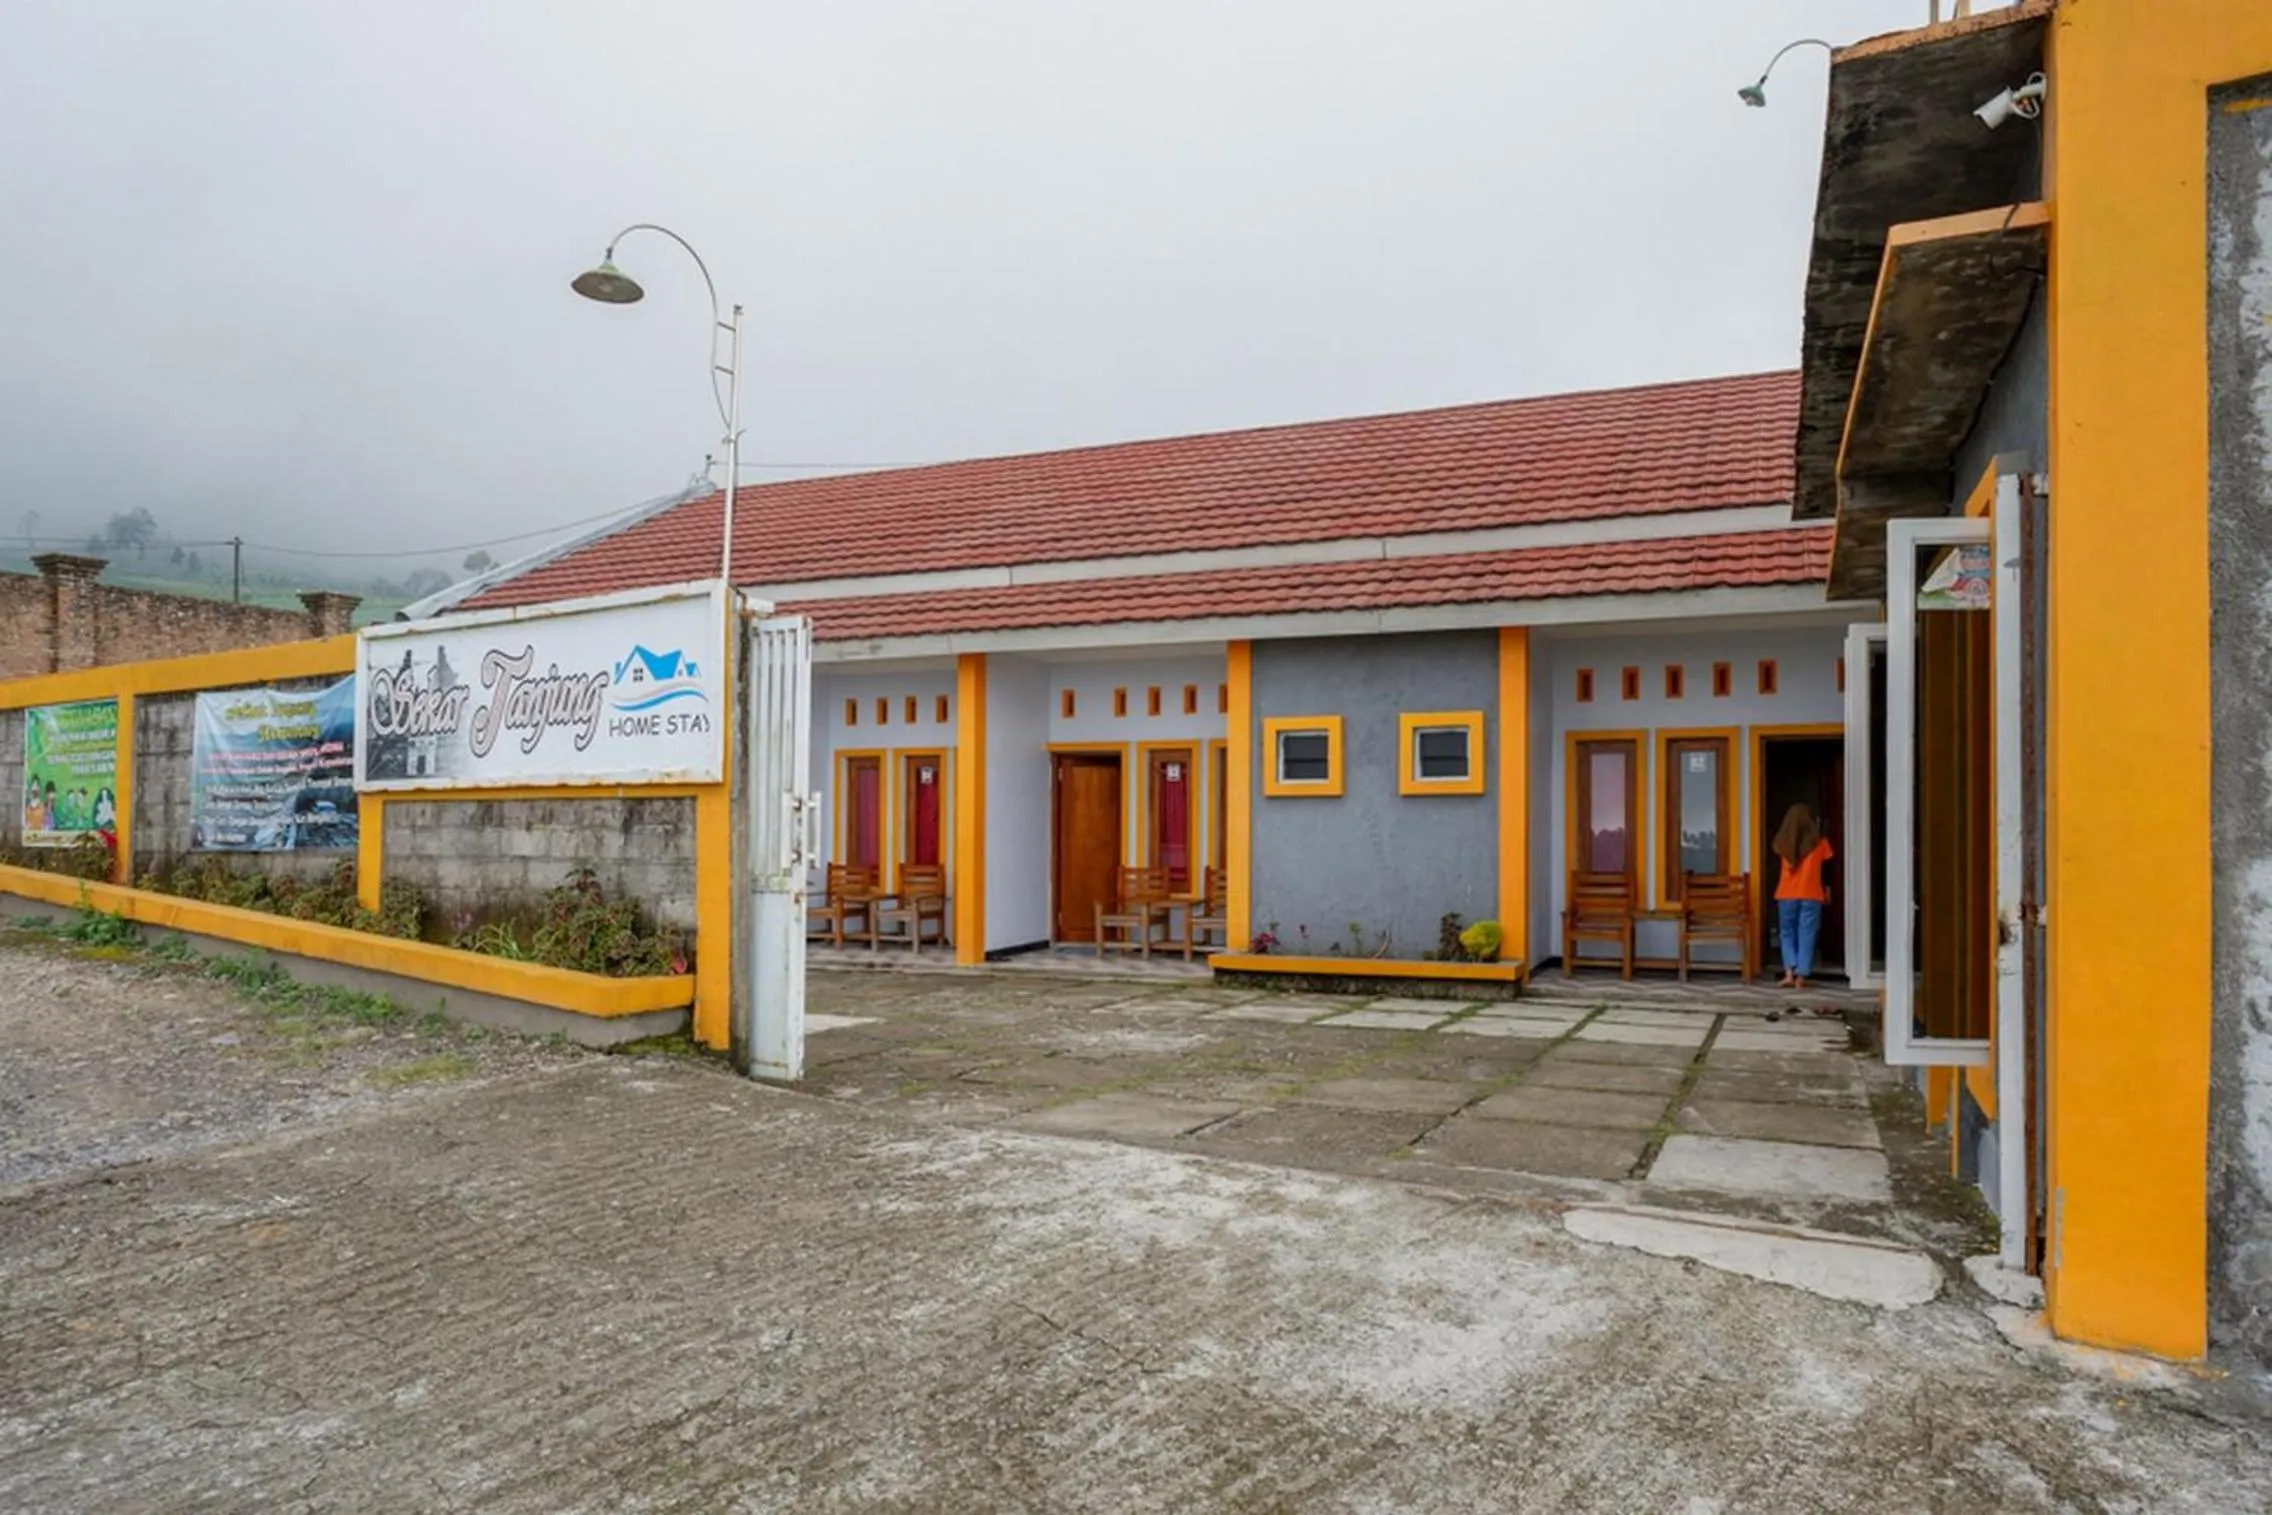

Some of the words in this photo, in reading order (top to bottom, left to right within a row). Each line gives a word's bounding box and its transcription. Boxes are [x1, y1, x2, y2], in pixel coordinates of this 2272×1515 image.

[371, 667, 470, 736] Sekar
[469, 644, 610, 757] Tanjung
[608, 714, 661, 737] HOME
